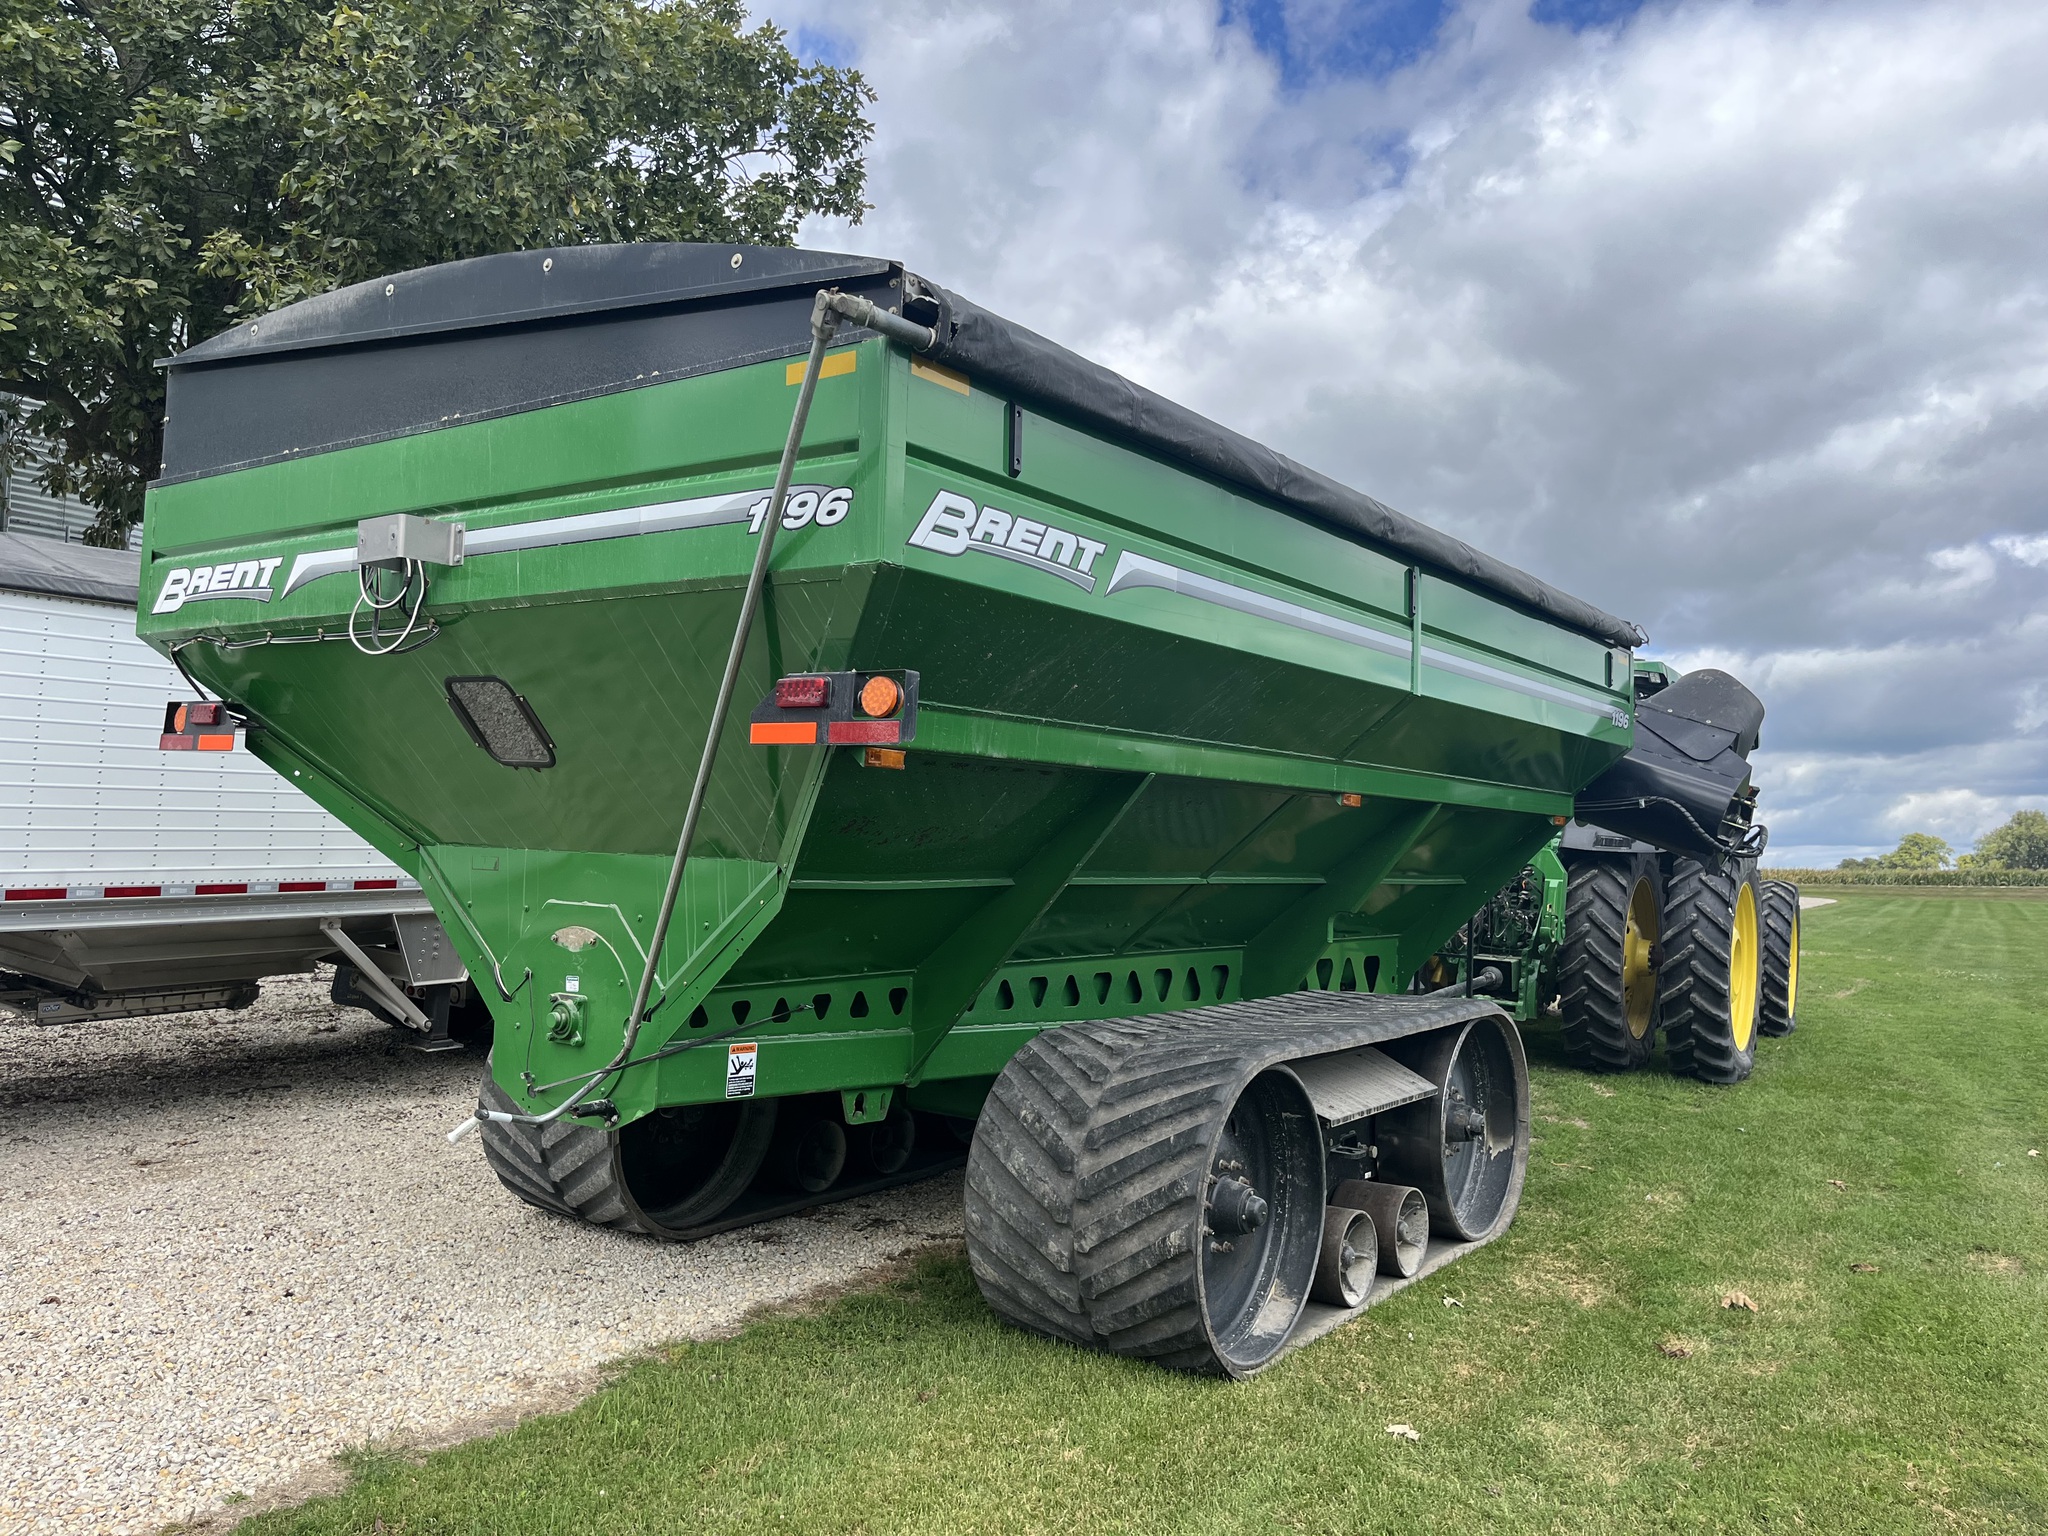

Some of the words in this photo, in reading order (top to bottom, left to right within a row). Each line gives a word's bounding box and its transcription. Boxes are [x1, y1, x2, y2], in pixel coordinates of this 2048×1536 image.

[905, 488, 1108, 580] BRENT
[151, 555, 284, 615] BRENT
[1611, 709, 1630, 730] 1196
